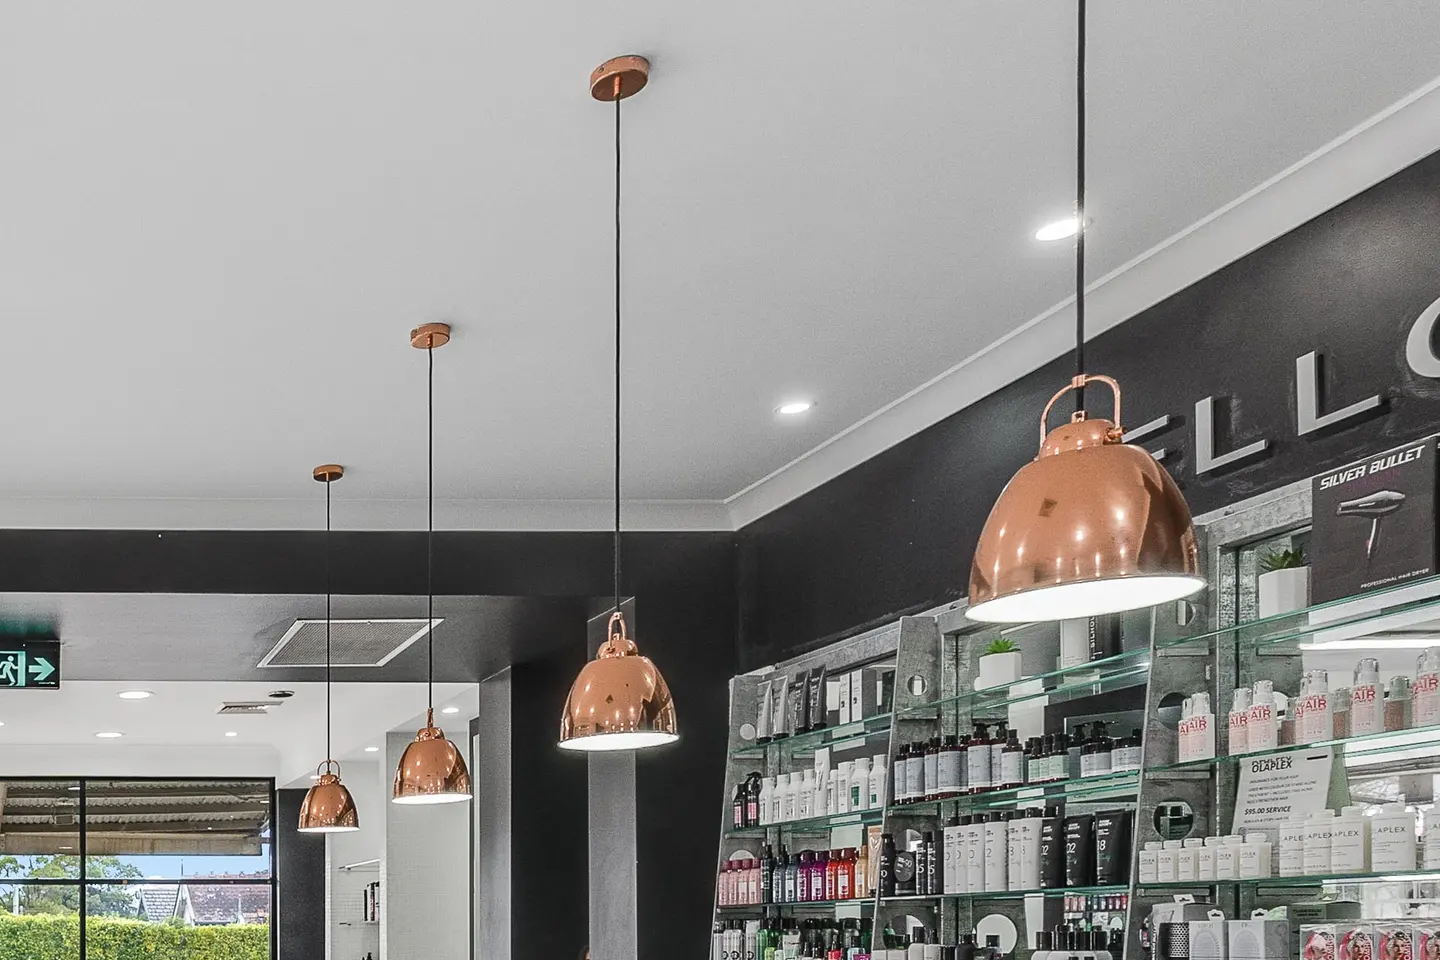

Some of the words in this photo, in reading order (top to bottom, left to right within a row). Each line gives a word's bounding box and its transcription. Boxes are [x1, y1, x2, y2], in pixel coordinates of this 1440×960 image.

[1320, 464, 1367, 491] SILVER
[1369, 445, 1426, 475] BULLET
[1360, 576, 1398, 589] PROFESSIONAL
[1251, 760, 1293, 773] OLAPLEX
[1265, 805, 1292, 814] SERVICE
